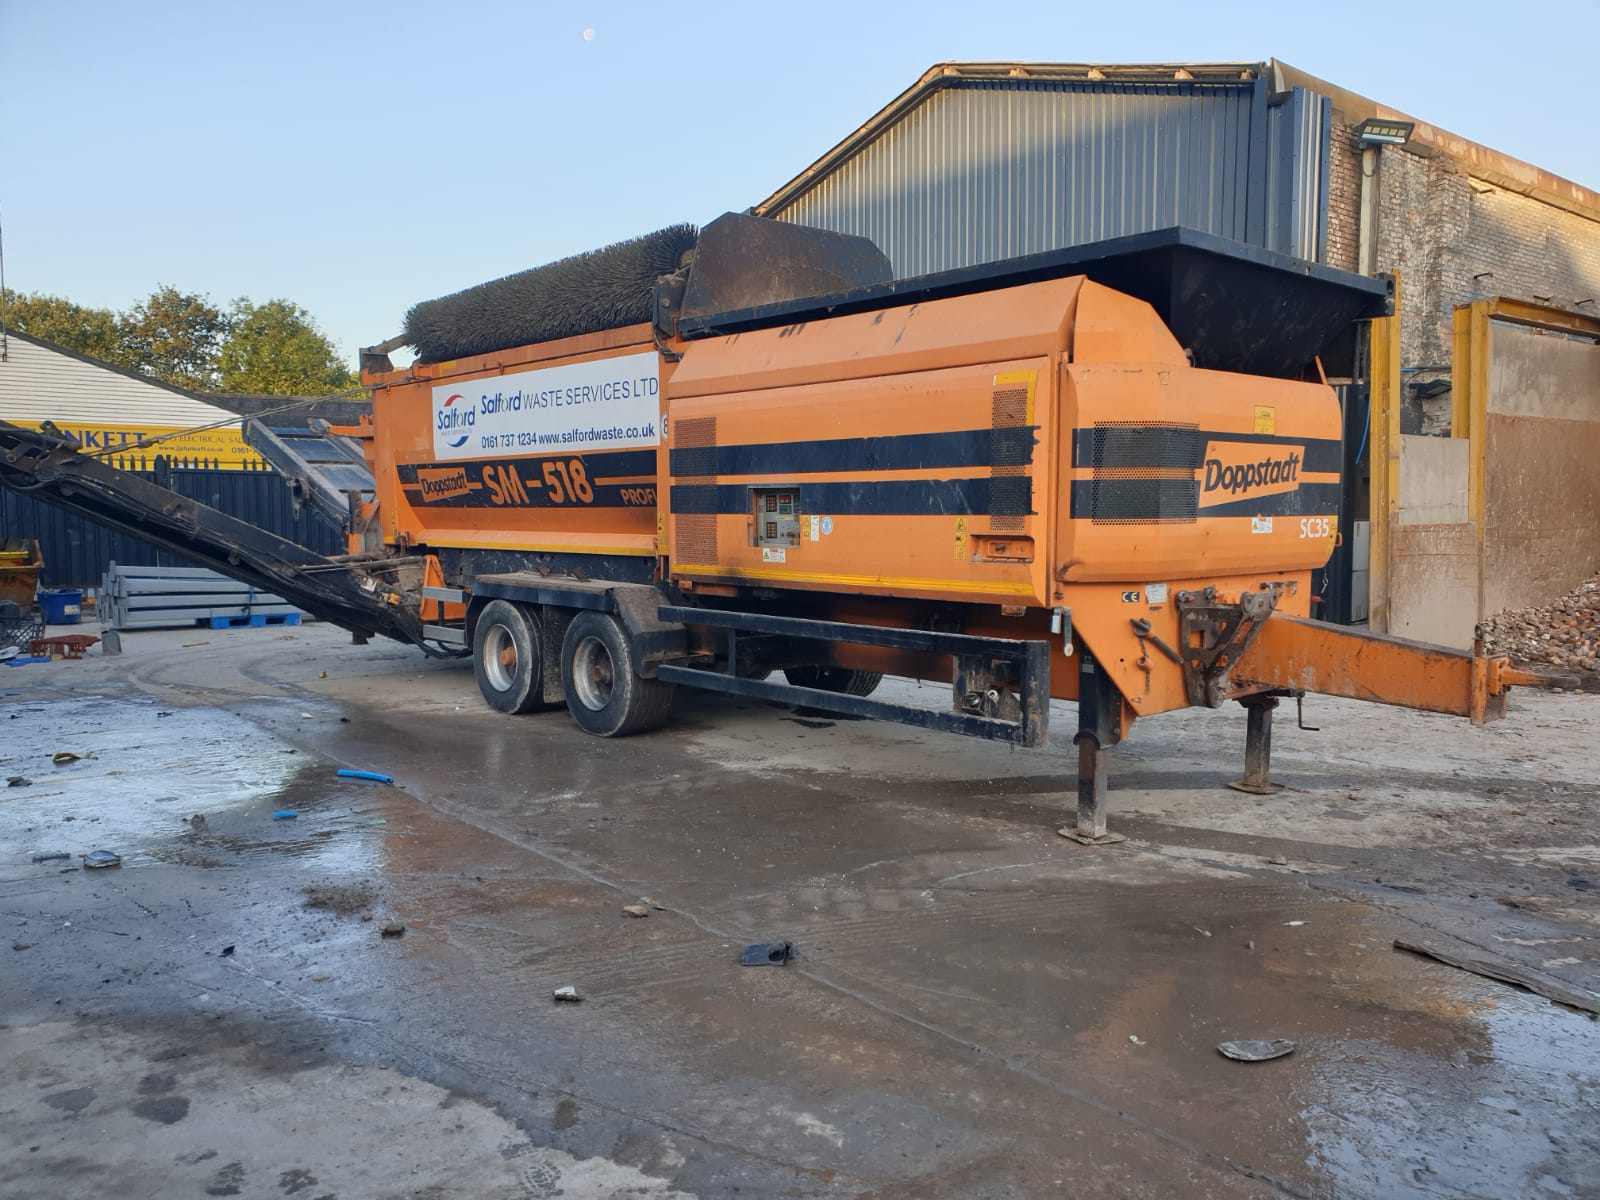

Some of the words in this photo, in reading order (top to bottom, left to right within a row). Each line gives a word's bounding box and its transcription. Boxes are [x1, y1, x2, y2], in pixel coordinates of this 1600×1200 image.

[481, 389, 522, 415] Salford
[522, 390, 563, 411] WASTE
[565, 380, 631, 406] SERVICES
[633, 377, 659, 398] LTD
[437, 405, 476, 431] Salford
[481, 435, 498, 449] 0161
[499, 433, 515, 448] 737
[516, 432, 537, 447] 1234
[538, 422, 656, 445] www.salfordwaste.co.uk
[420, 471, 468, 496] Doppstadt
[1203, 452, 1300, 495] Doppstadt
[1299, 518, 1330, 539] SC35
